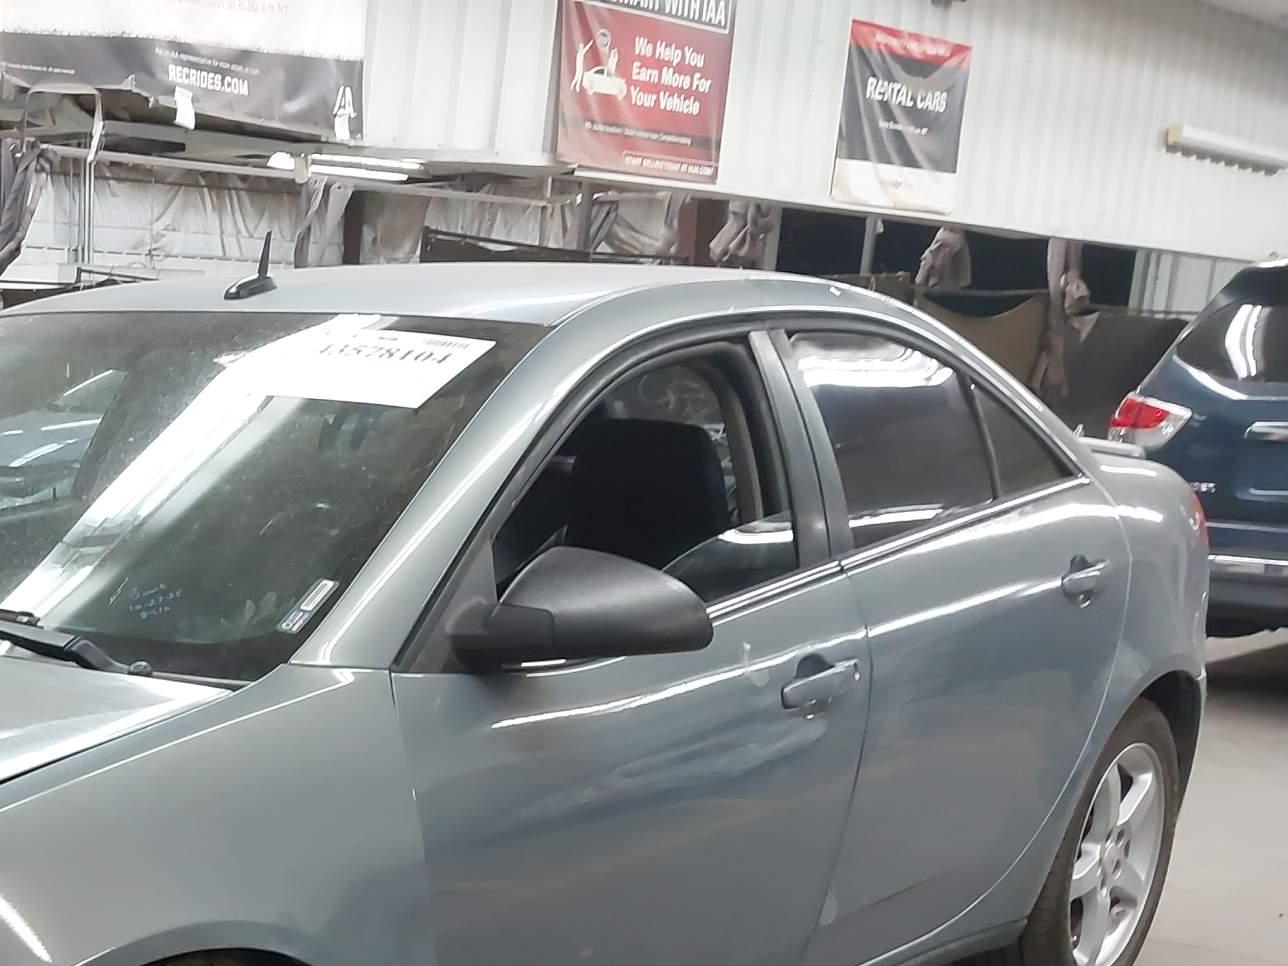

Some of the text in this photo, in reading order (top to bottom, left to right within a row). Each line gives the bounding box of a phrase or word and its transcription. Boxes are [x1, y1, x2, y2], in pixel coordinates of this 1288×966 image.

[700, 0, 726, 26] IAA
[635, 36, 705, 68] We Help You
[168, 64, 249, 96] RECRIDES.COM
[632, 61, 712, 93] Earn More For
[630, 85, 700, 115] Your Vehicle
[865, 76, 948, 113] RENTAL CARS
